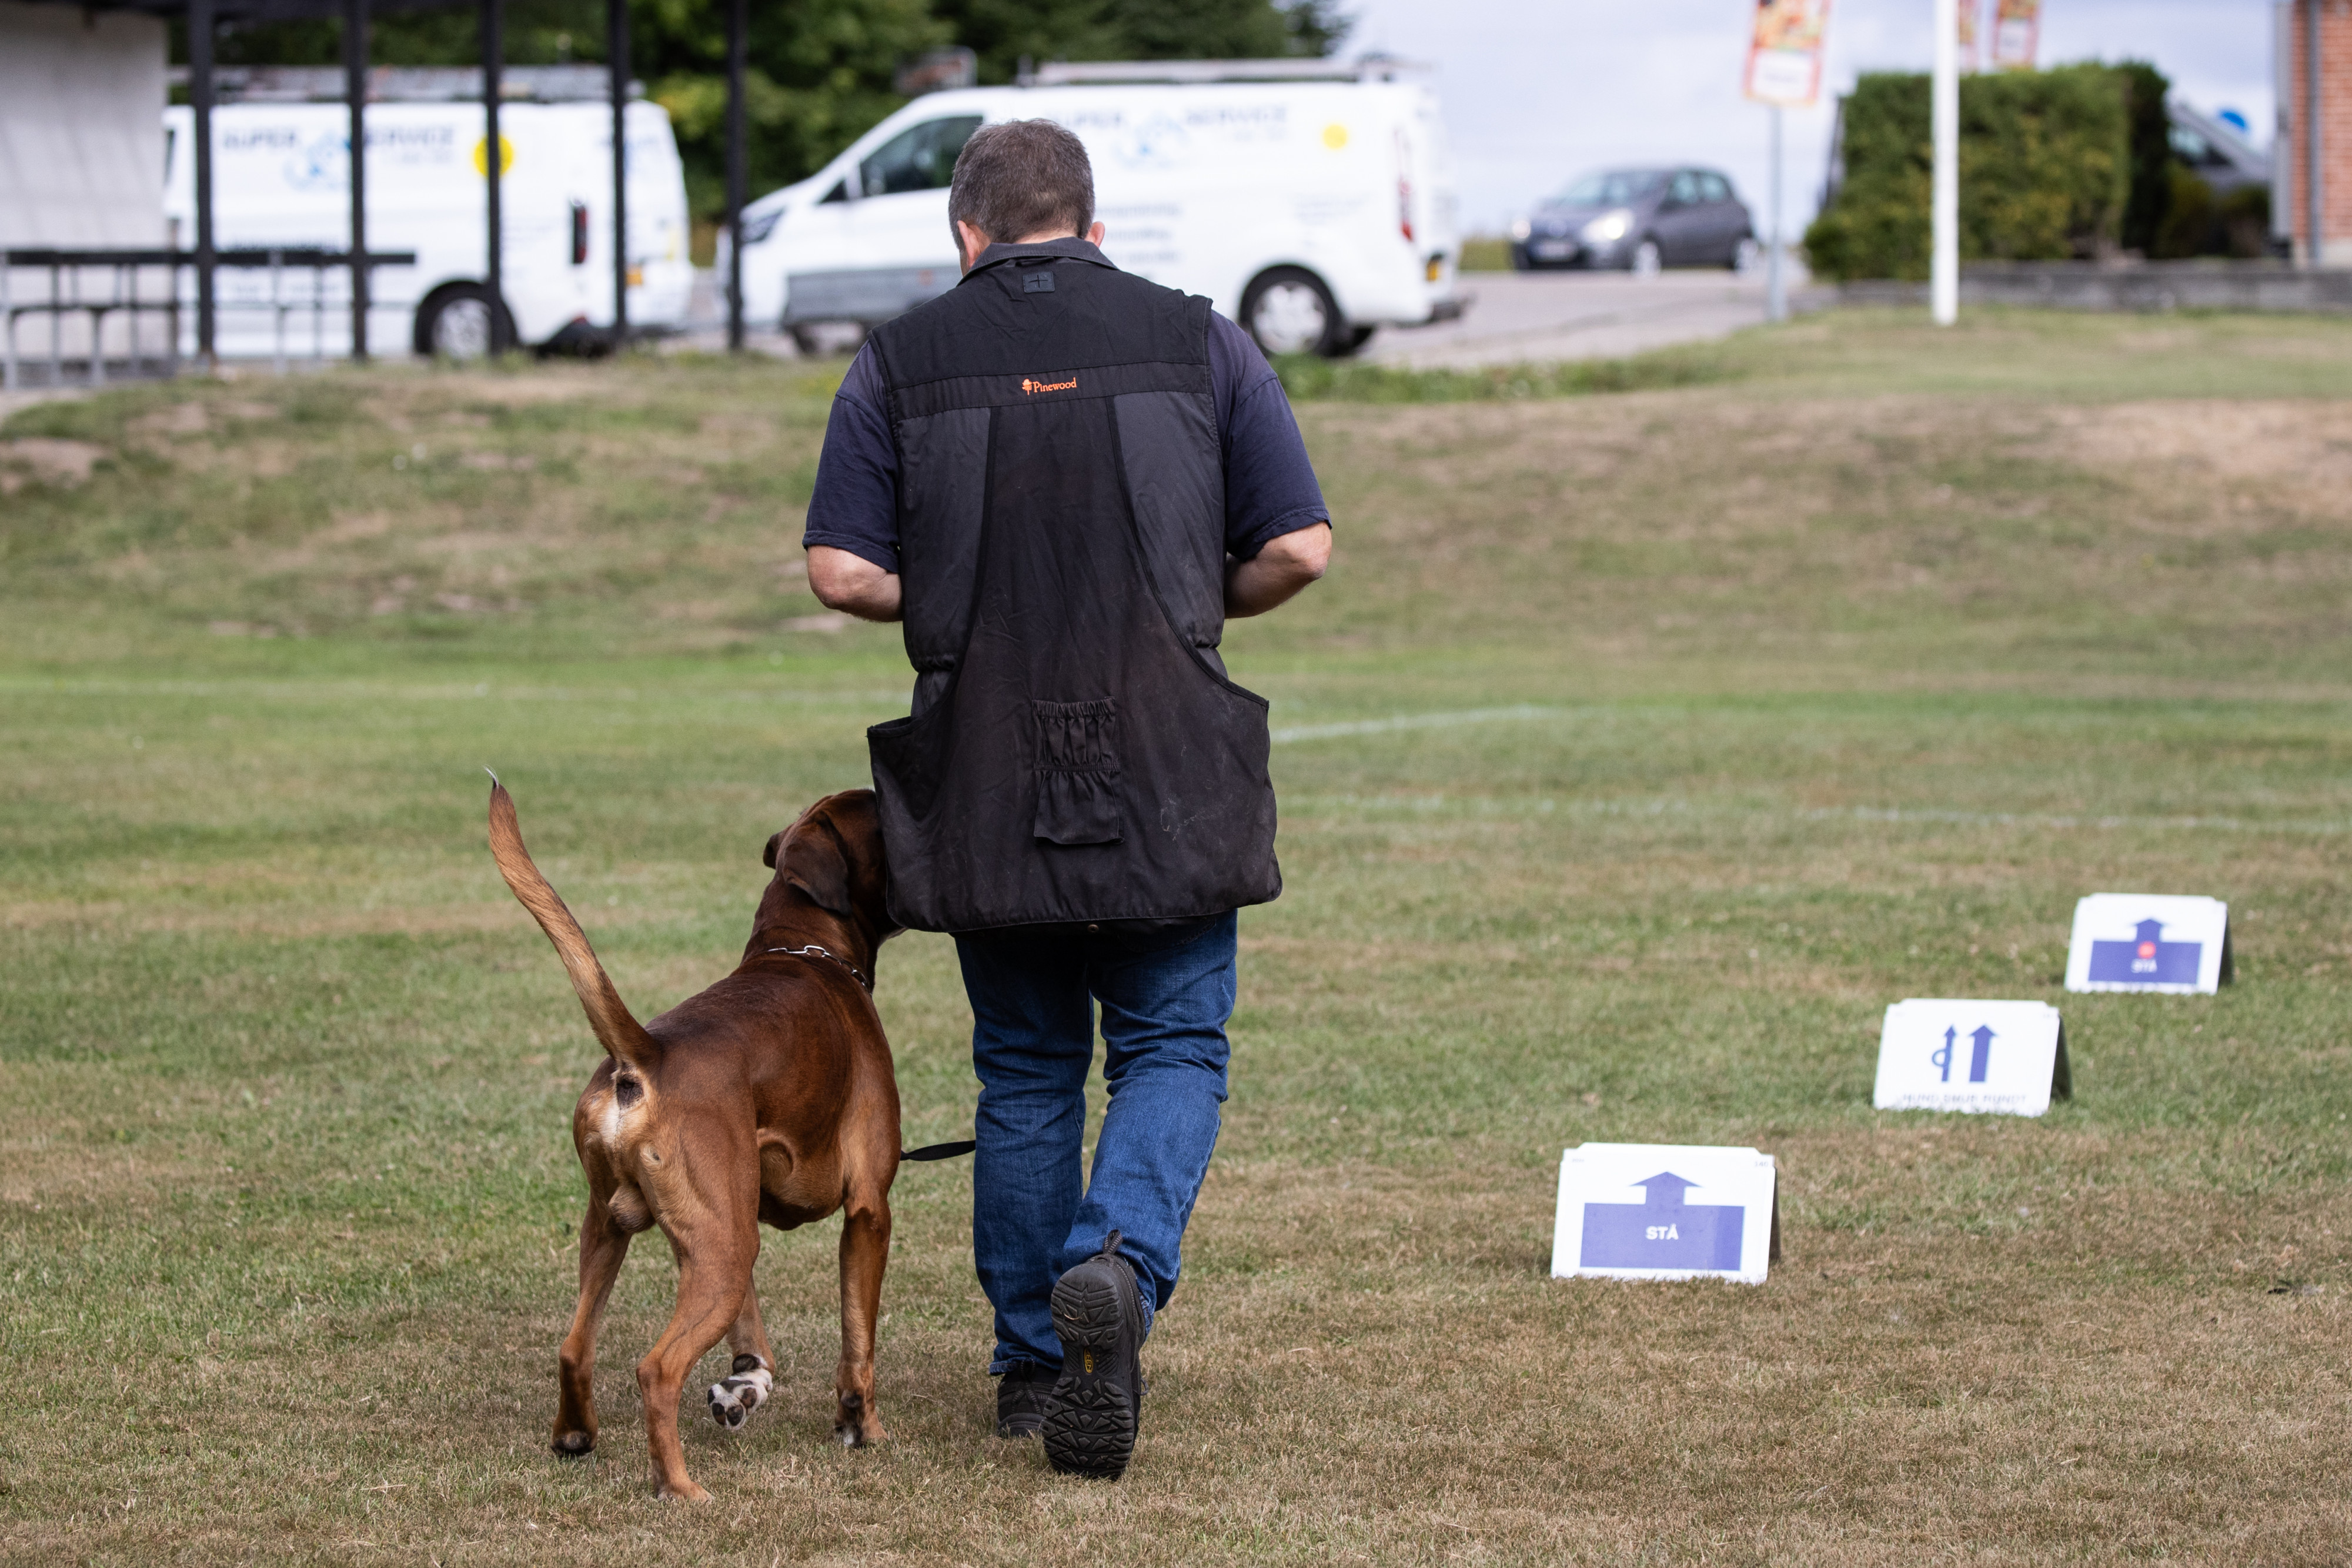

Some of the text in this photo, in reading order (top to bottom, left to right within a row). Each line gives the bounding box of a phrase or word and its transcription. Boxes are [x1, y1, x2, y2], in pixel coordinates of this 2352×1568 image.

[363, 124, 454, 146] ERVICE
[1033, 377, 1077, 393] Pinewood
[1646, 1223, 1679, 1240] STÅ
